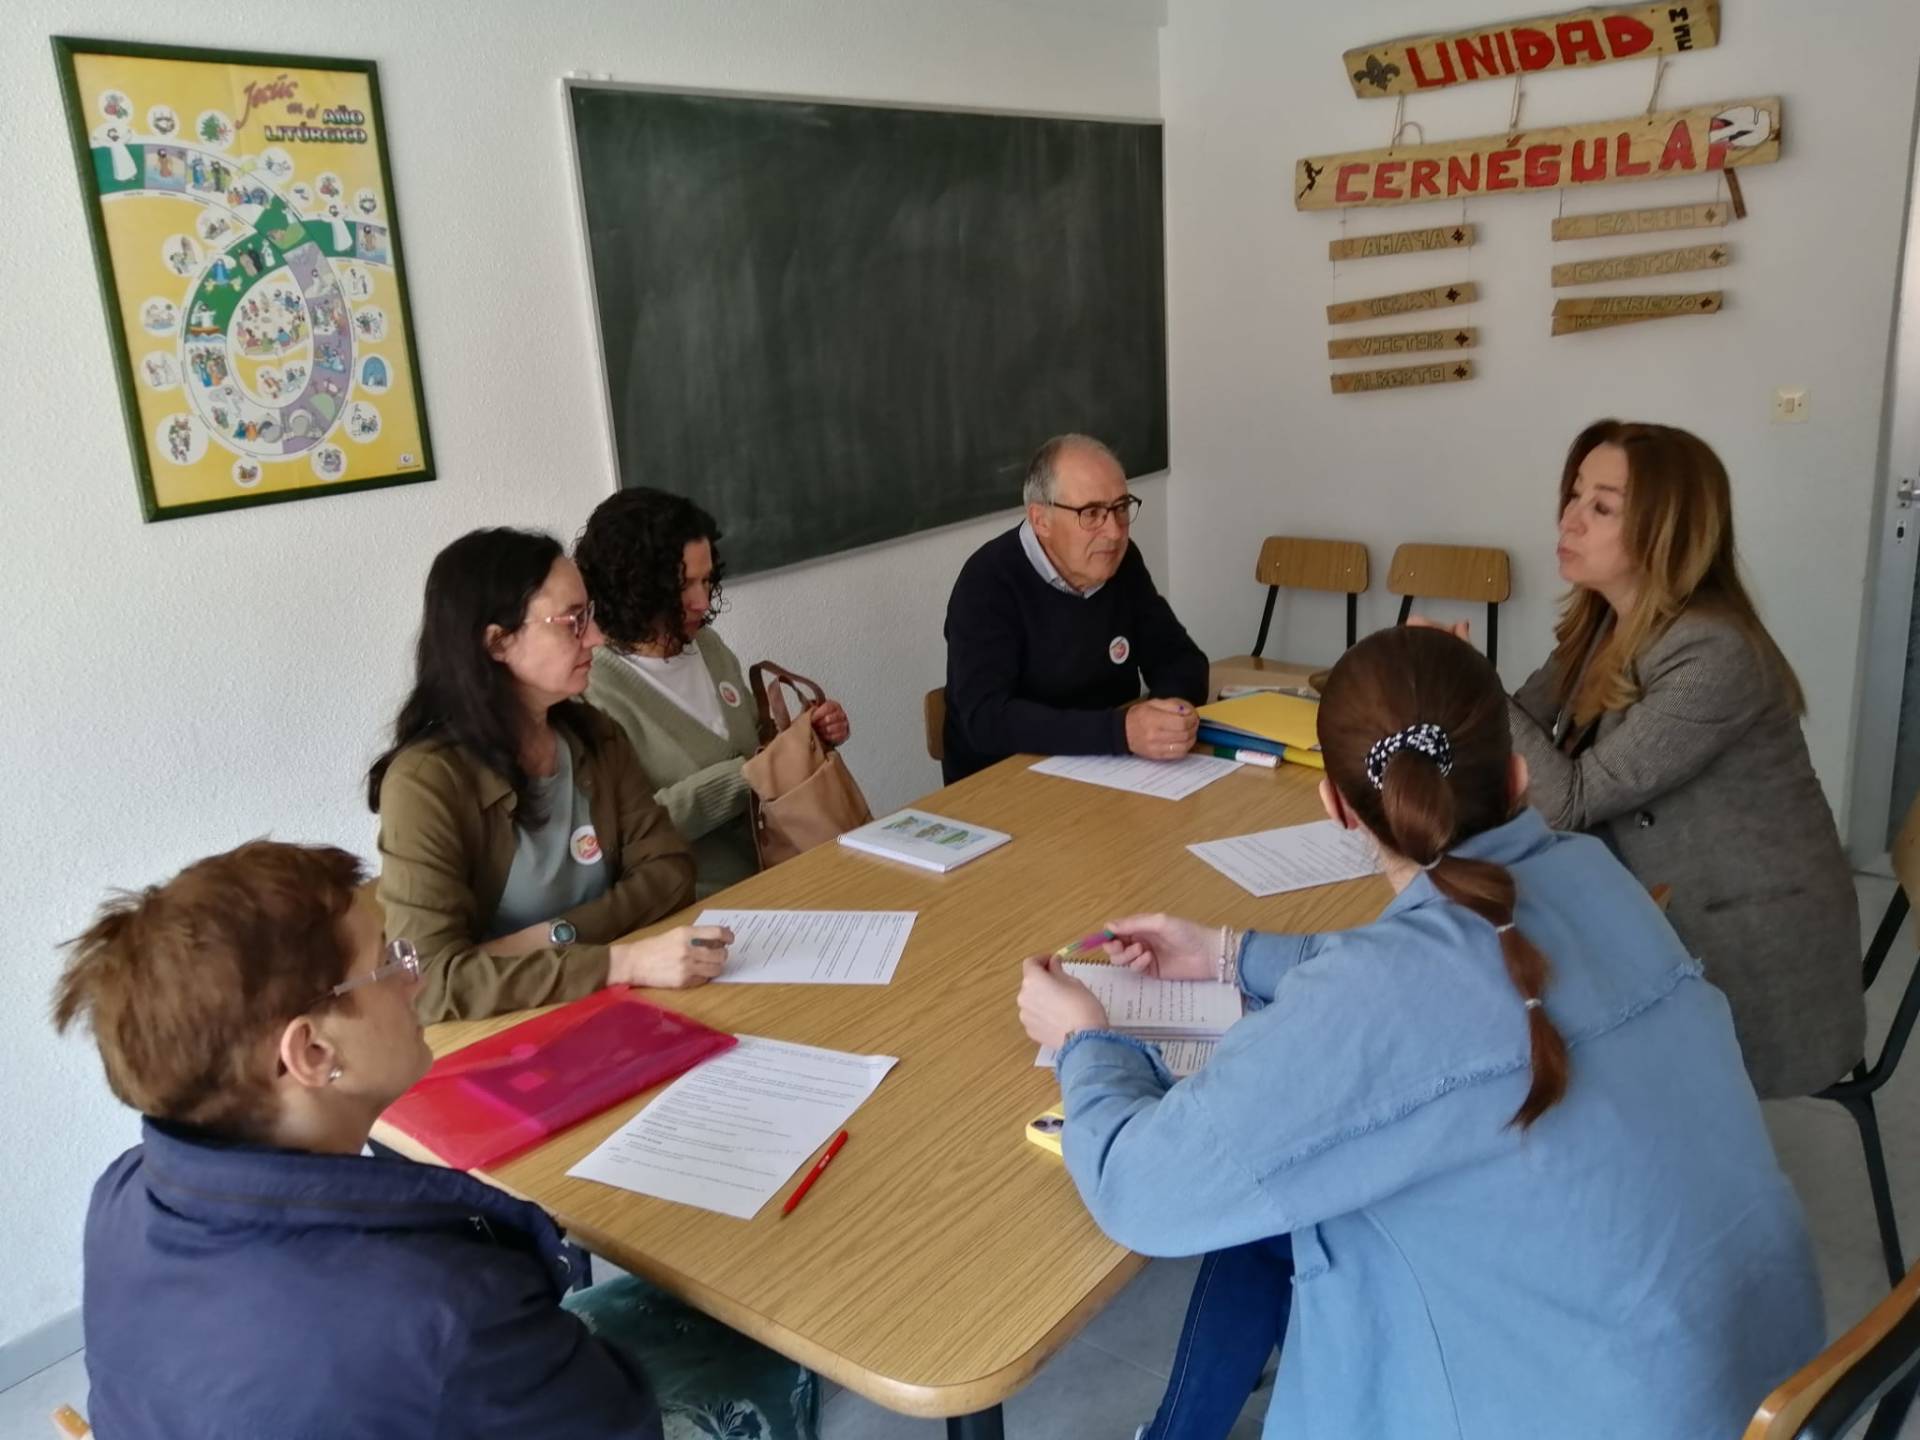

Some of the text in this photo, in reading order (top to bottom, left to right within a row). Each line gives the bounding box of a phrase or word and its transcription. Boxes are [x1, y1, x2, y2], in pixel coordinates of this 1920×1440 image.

[1405, 14, 1655, 90] UNIDAD
[322, 105, 365, 125] AÑO
[263, 121, 368, 143] LITÚRGICO
[1333, 118, 1697, 203] CERNÉGULA
[1360, 228, 1448, 258] AMAYA
[1358, 332, 1445, 354] VICTOR
